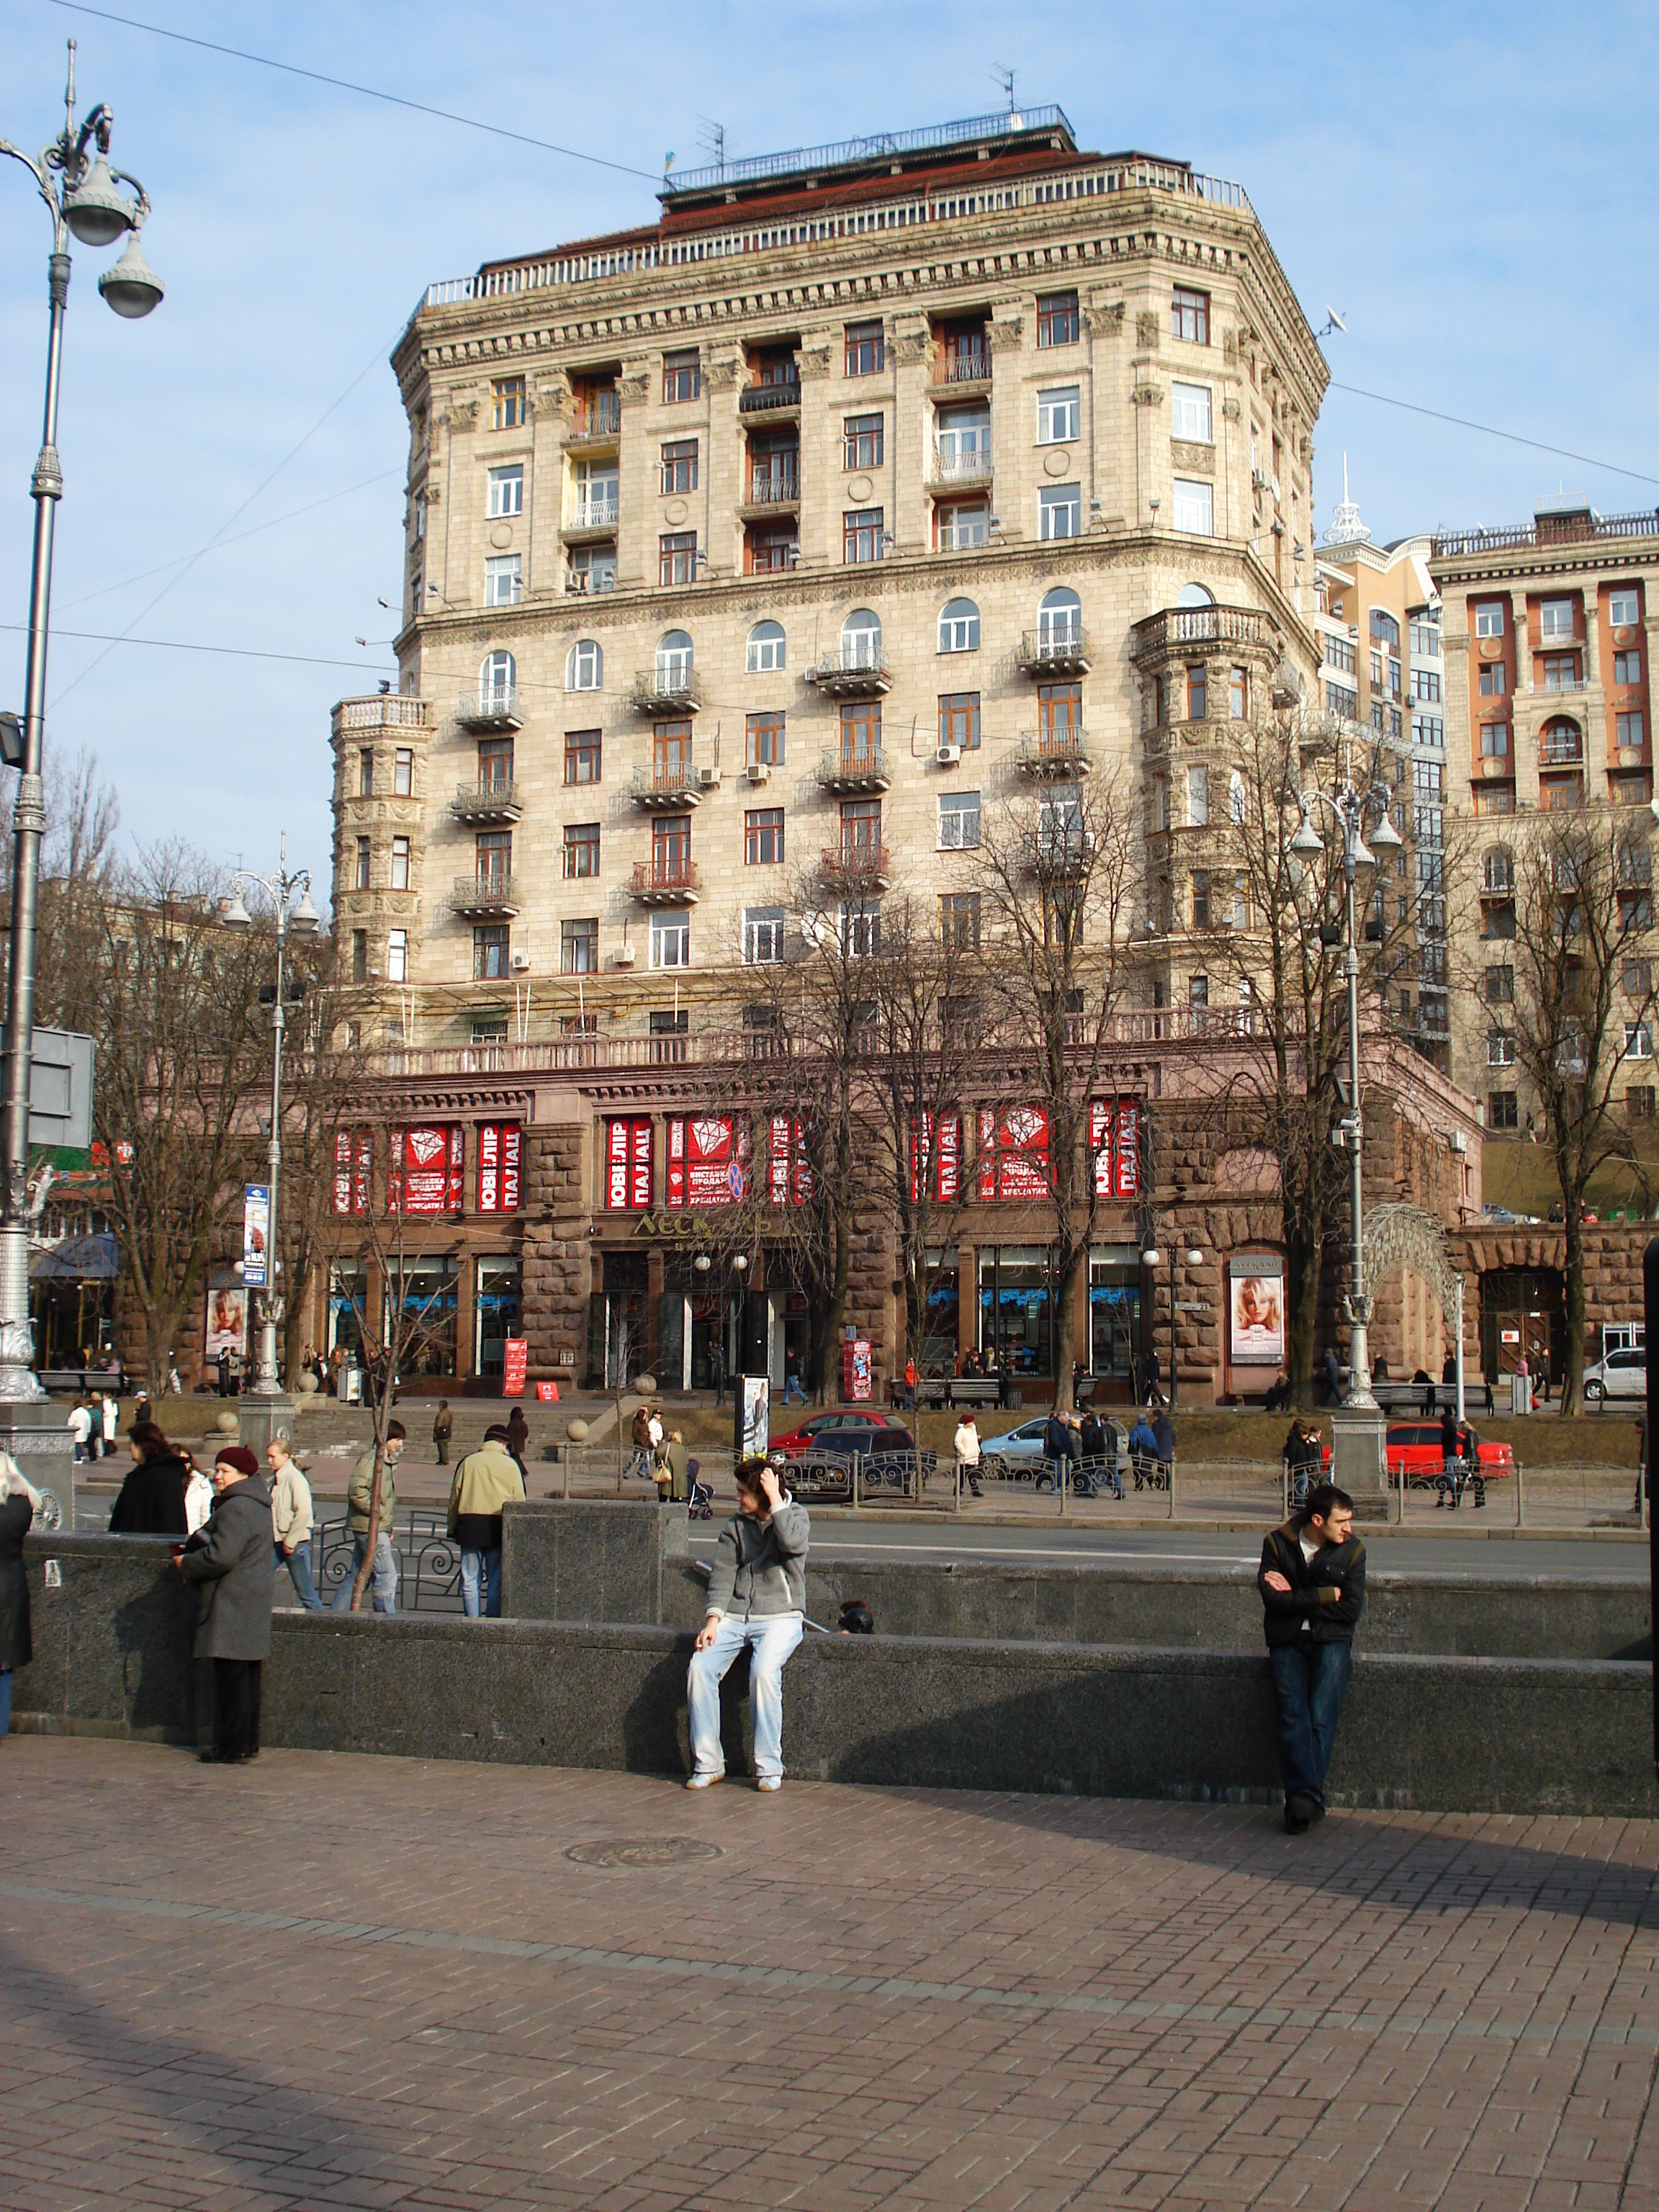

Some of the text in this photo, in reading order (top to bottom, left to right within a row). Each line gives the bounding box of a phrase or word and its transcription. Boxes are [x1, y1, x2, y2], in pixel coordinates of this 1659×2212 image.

[482, 1126, 498, 1210] ЮВЕЛІР
[505, 1132, 521, 1206] ПАЛАЦ
[611, 1122, 627, 1208] ЮВЕЛІР
[634, 1128, 651, 1203] ПАЛАЦ
[941, 1117, 958, 1195] ПАЛАЦ
[1120, 1109, 1136, 1190] ПАЛАЦ
